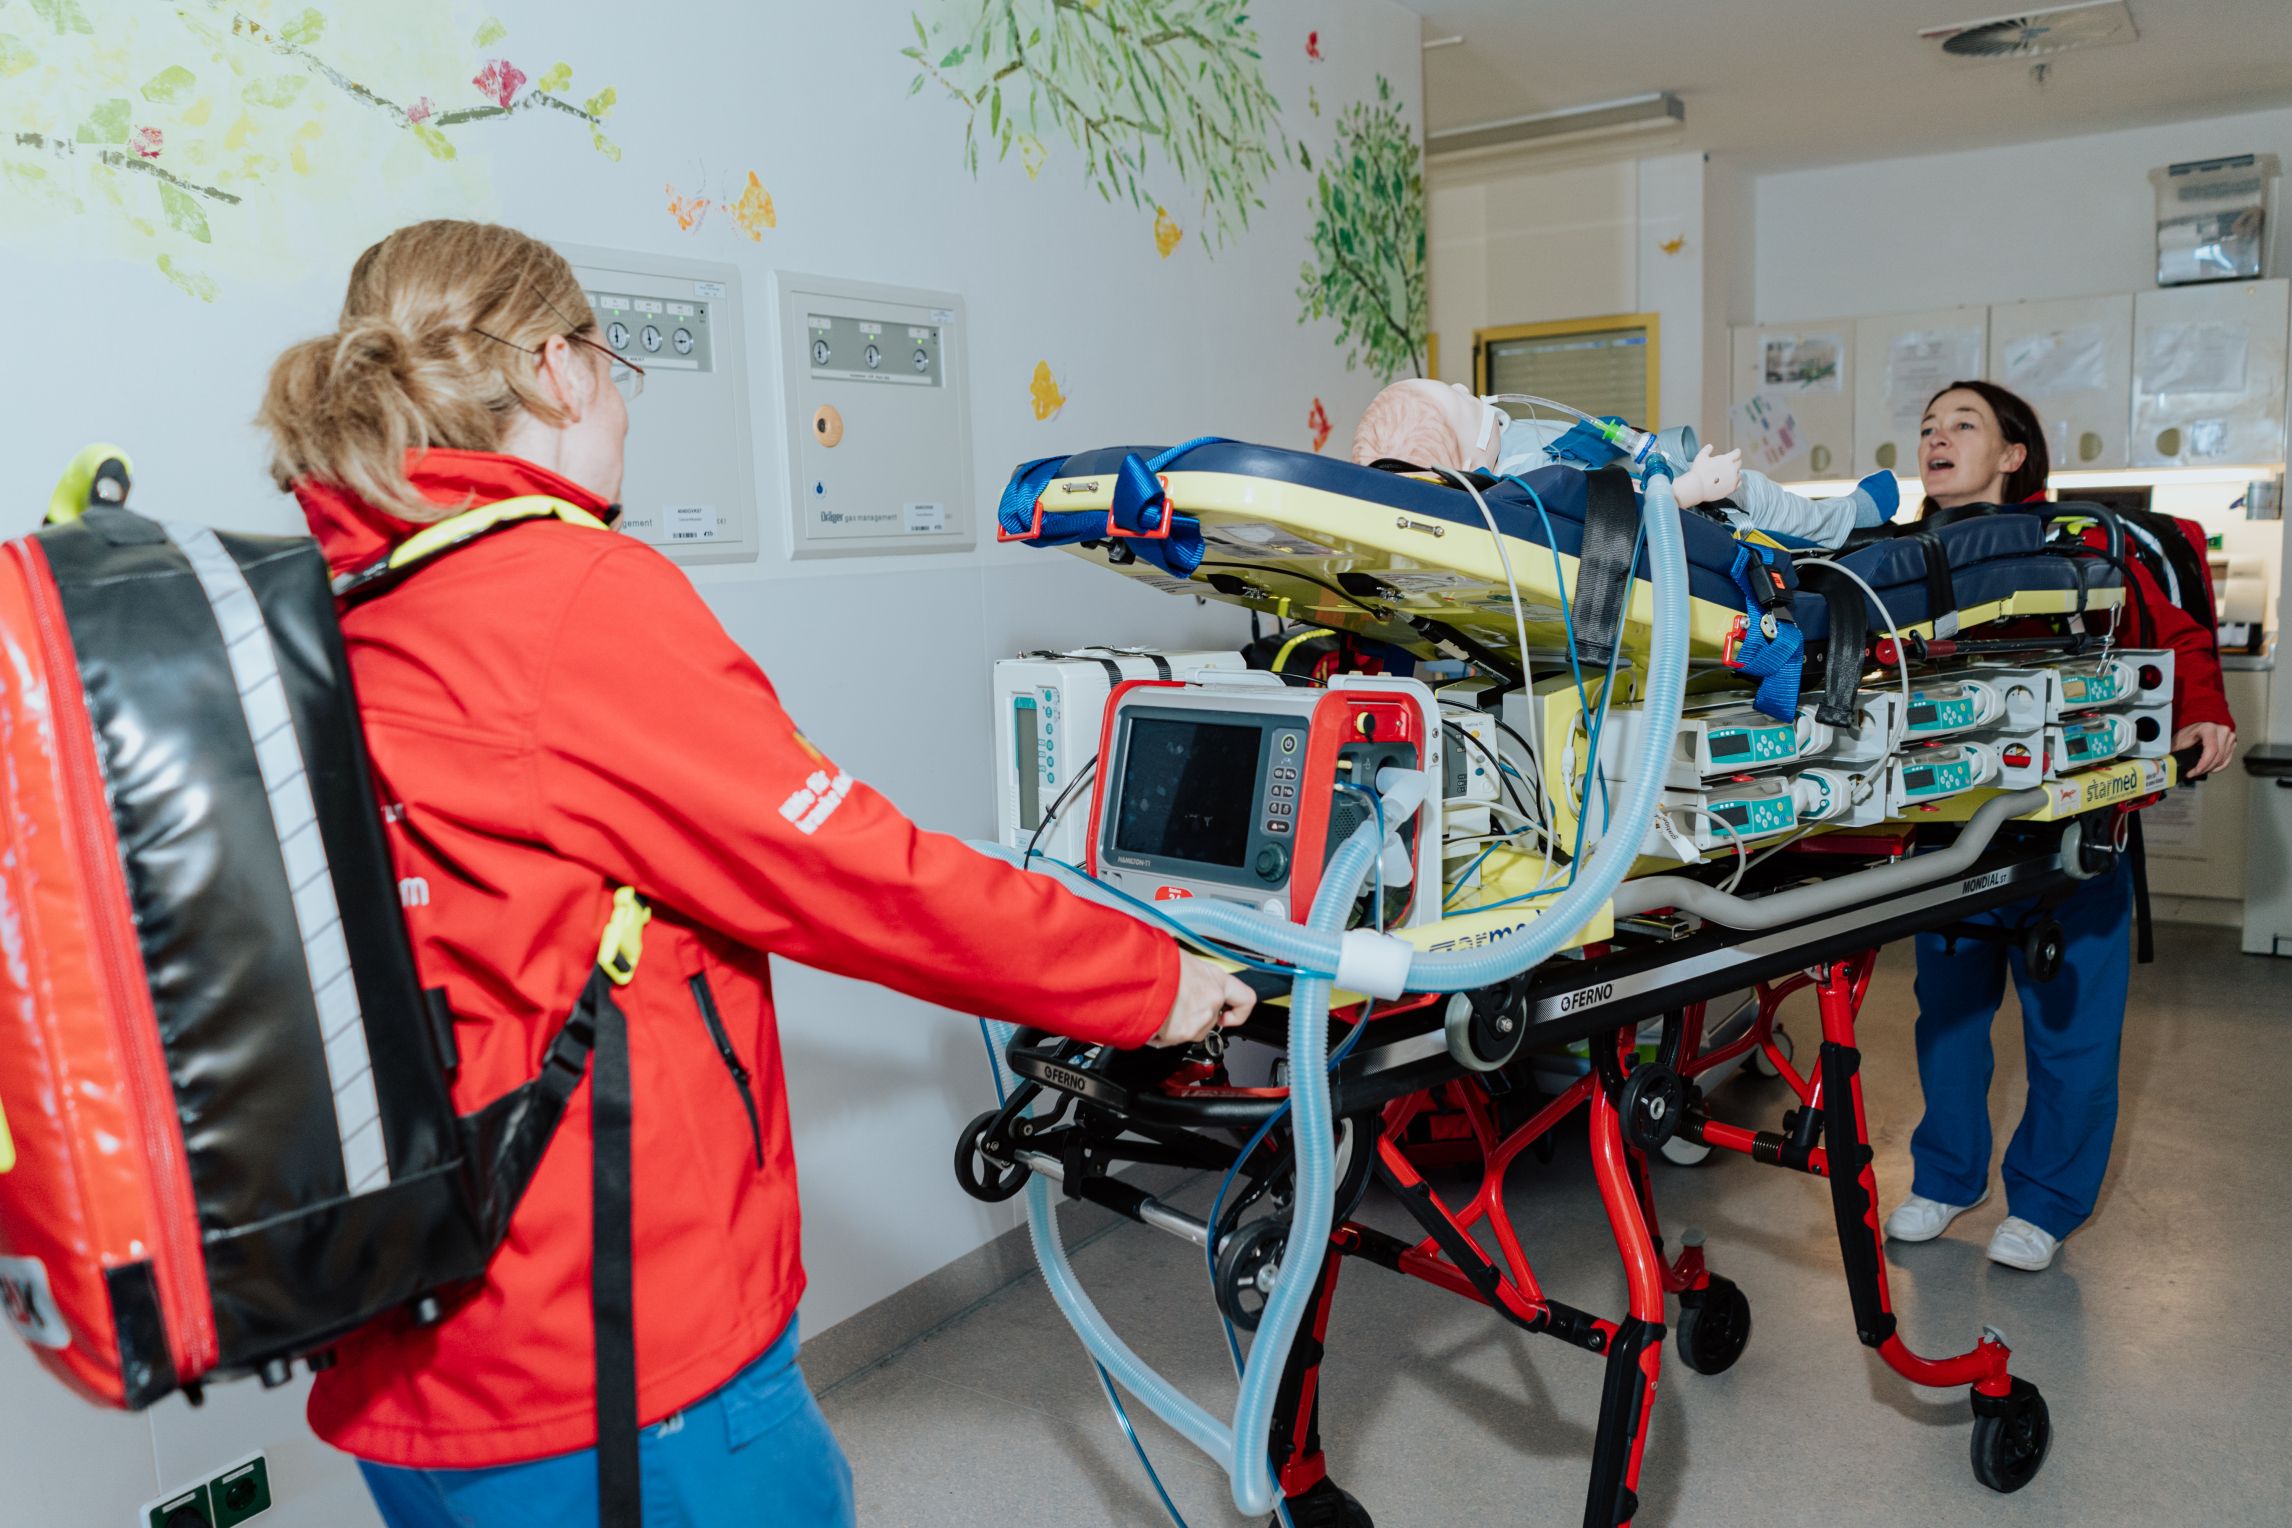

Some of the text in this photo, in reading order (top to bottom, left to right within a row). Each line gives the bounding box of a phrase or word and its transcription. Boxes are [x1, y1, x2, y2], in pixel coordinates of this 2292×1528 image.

[821, 510, 898, 524] Dräger gas management
[1962, 873, 2008, 895] MONDIAL ST
[1572, 983, 1613, 1010] FERNO
[1052, 1068, 1086, 1091] FERNO
